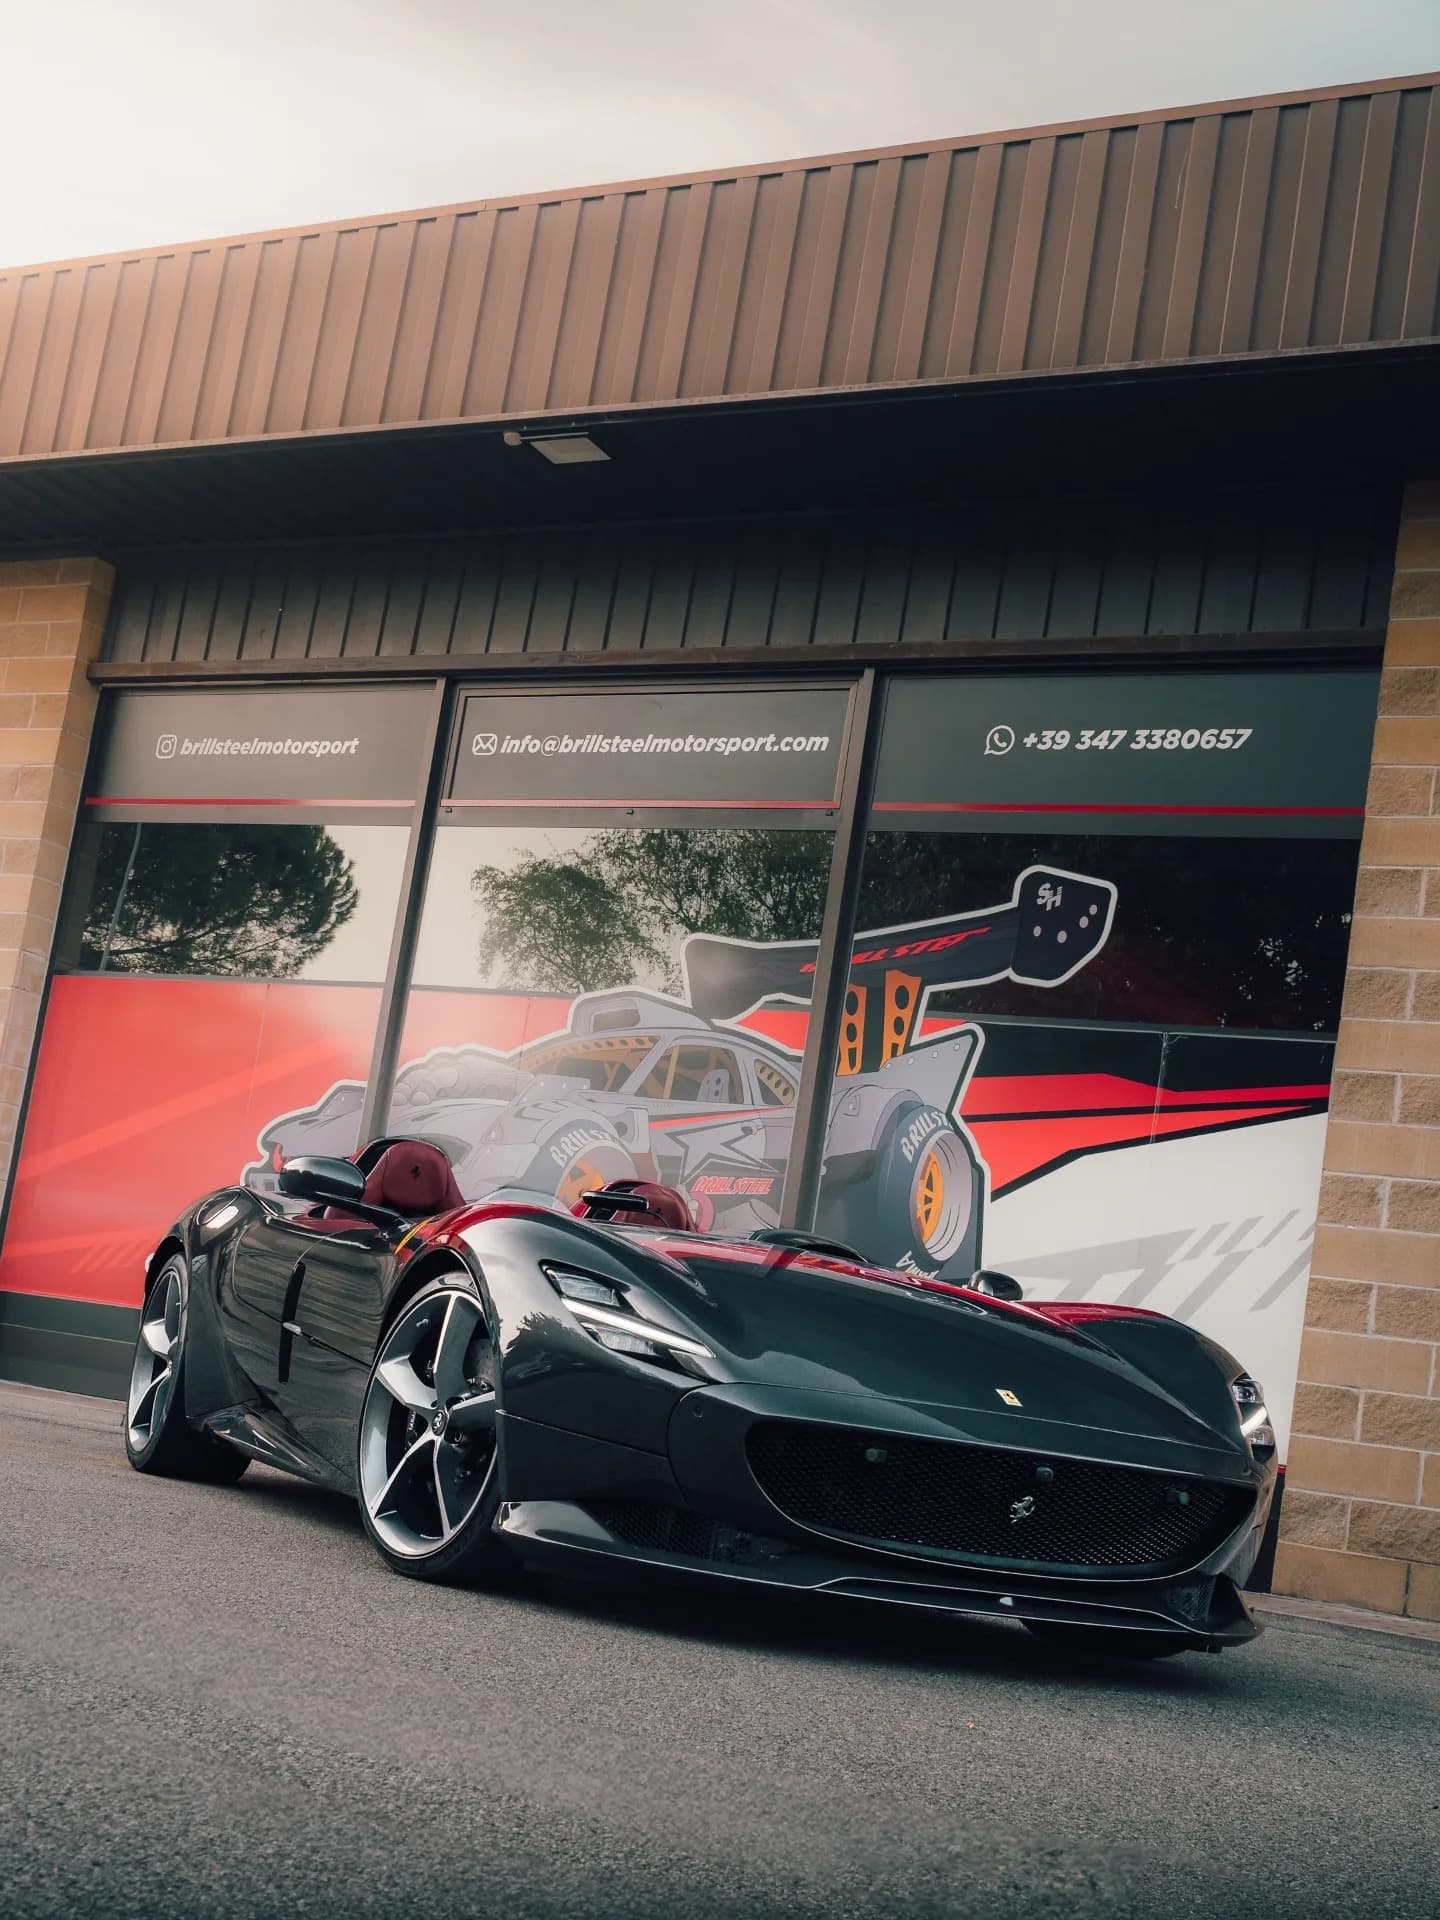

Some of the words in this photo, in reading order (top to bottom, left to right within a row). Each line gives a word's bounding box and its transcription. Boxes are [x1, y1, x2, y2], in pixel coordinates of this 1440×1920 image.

[180, 737, 360, 757] brillsteelmotorsport
[500, 733, 830, 756] info@brillsteelmotorsport.com
[1022, 730, 1070, 750] +39
[1075, 729, 1128, 750] 347
[1130, 728, 1253, 750] 3380657
